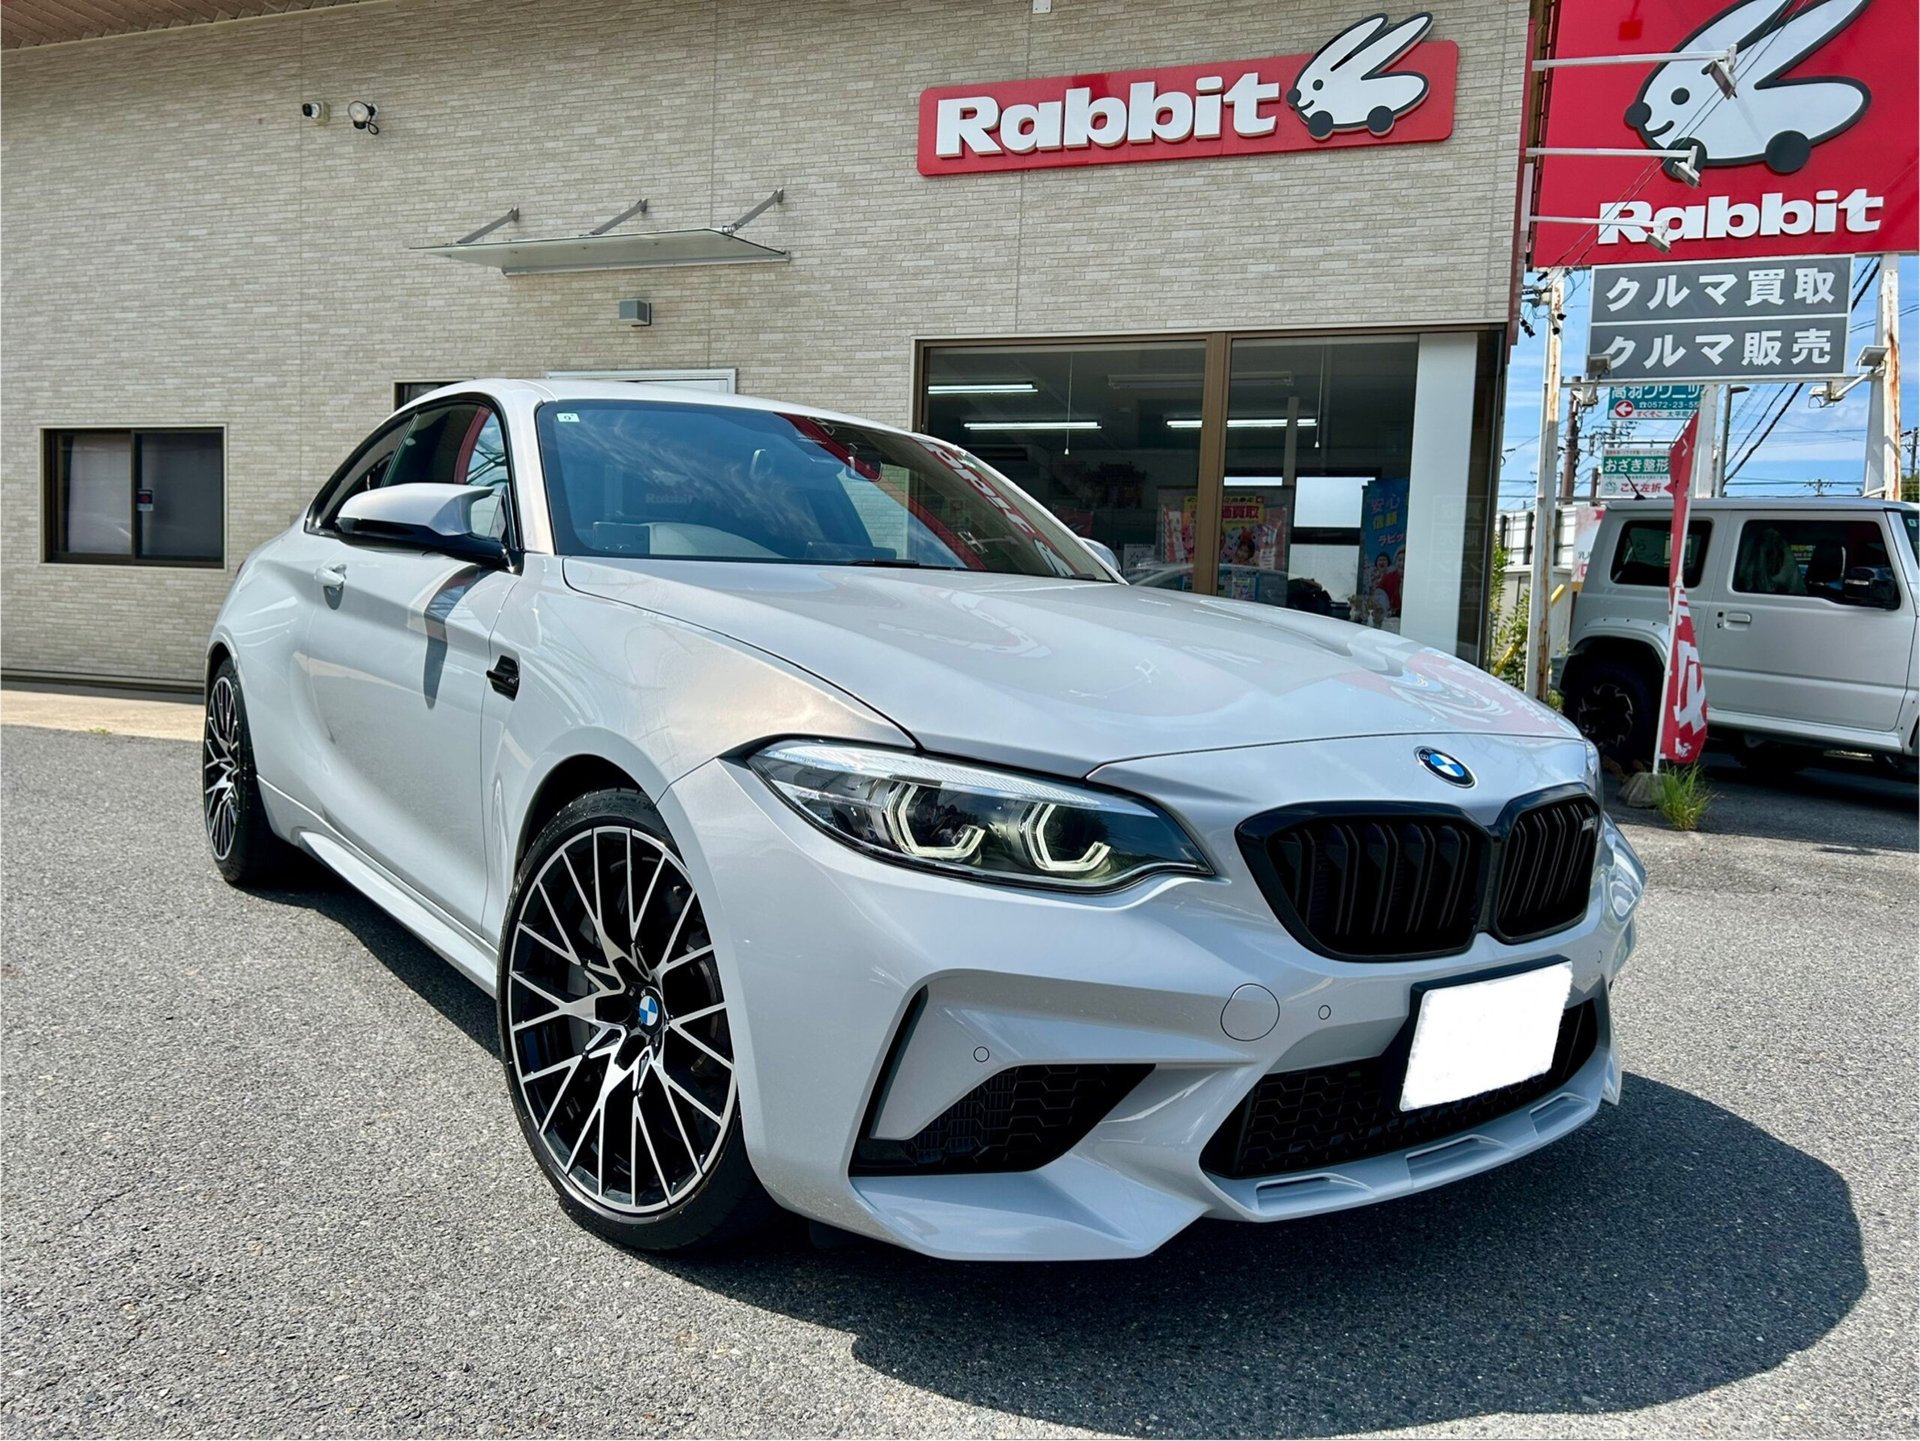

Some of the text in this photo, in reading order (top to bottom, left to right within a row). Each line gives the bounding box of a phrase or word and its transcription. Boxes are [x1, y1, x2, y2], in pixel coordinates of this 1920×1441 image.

[935, 72, 1279, 159] Rabbit
[1598, 188, 1884, 245] Rabbit
[1606, 266, 1835, 313] クルマ買取
[1607, 328, 1832, 370] クルマ販売
[1604, 458, 1669, 473] おざき整形
